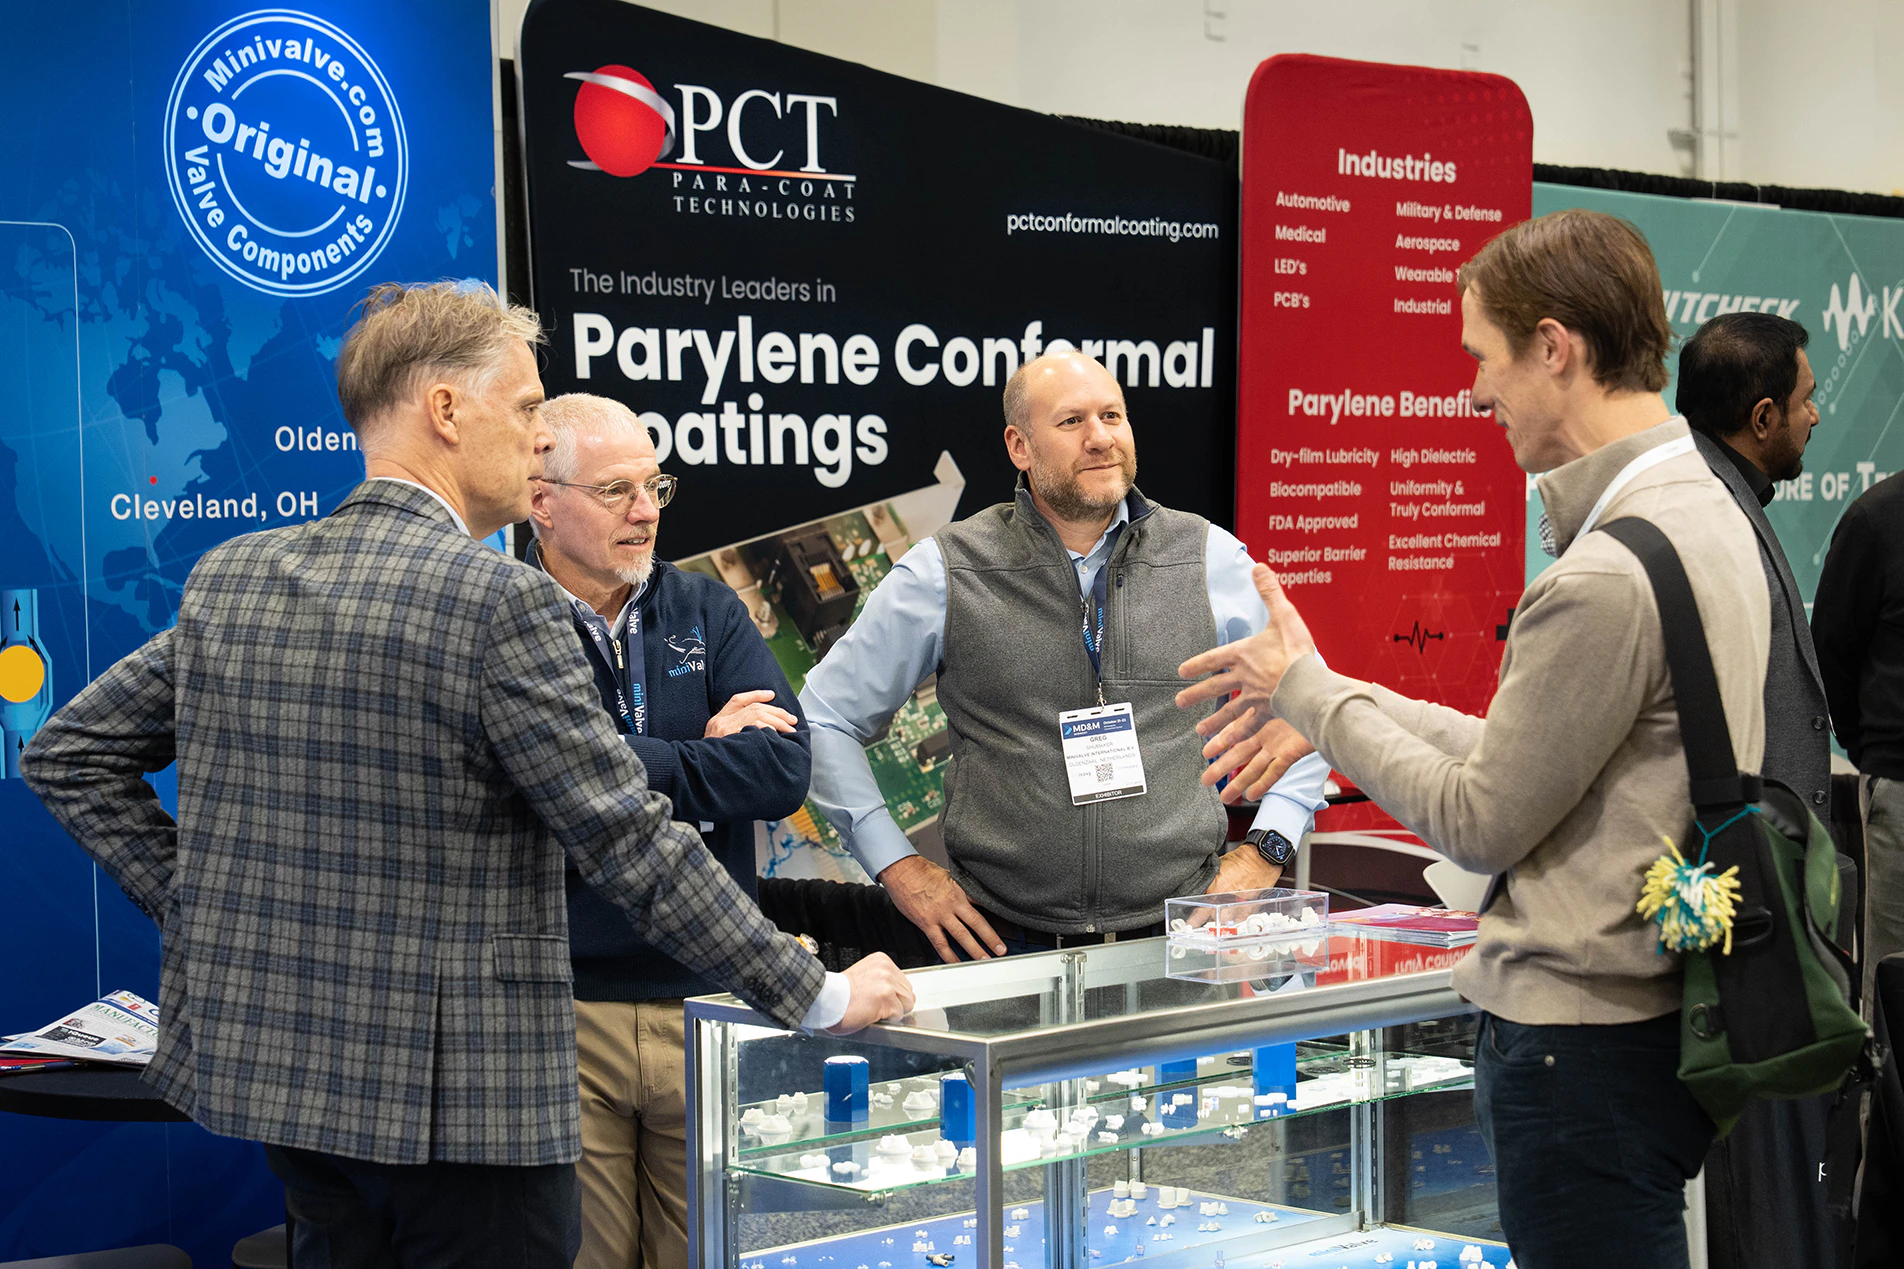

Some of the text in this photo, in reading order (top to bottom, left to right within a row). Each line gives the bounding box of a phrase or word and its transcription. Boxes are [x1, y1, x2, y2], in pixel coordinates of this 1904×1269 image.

[203, 35, 384, 158] Minivalve.com
[673, 84, 838, 173] PCT
[202, 102, 376, 204] Original
[1338, 148, 1457, 184] Industries
[673, 172, 855, 199] PARA-COAT
[185, 145, 373, 281] Valve Components
[673, 196, 855, 222] TECHNOLOGIES
[1276, 191, 1350, 212] Automotive
[1396, 202, 1502, 223] Military & Defense
[1007, 211, 1220, 243] pctconformalcoating.com
[1275, 224, 1326, 244] Medical
[1396, 234, 1460, 254] Aerospace
[570, 268, 836, 305] The Industry Leaders in
[1395, 266, 1453, 282] Wearable
[1394, 298, 1452, 314] Industrial
[572, 312, 880, 405] Parylene
[1288, 388, 1395, 425] Parylene
[274, 425, 357, 452] Olden
[636, 392, 889, 488] oatings
[1270, 448, 1380, 468] Dry-film Lubricity
[1390, 448, 1476, 468] High Dielectric
[1270, 480, 1362, 501] Biocompatible
[1390, 480, 1464, 499] Uniformity &
[1820, 472, 1850, 502] OF
[110, 491, 318, 522] Cleveland, OH
[1390, 501, 1486, 521] Truly Conformal
[1269, 513, 1358, 534] FDA Approved
[1388, 531, 1501, 550] Excellent Chemical
[1268, 544, 1367, 568] Superior Barrier
[1388, 554, 1454, 571] Resistance
[634, 683, 645, 734] miniValve
[1072, 722, 1100, 732] MD&M
